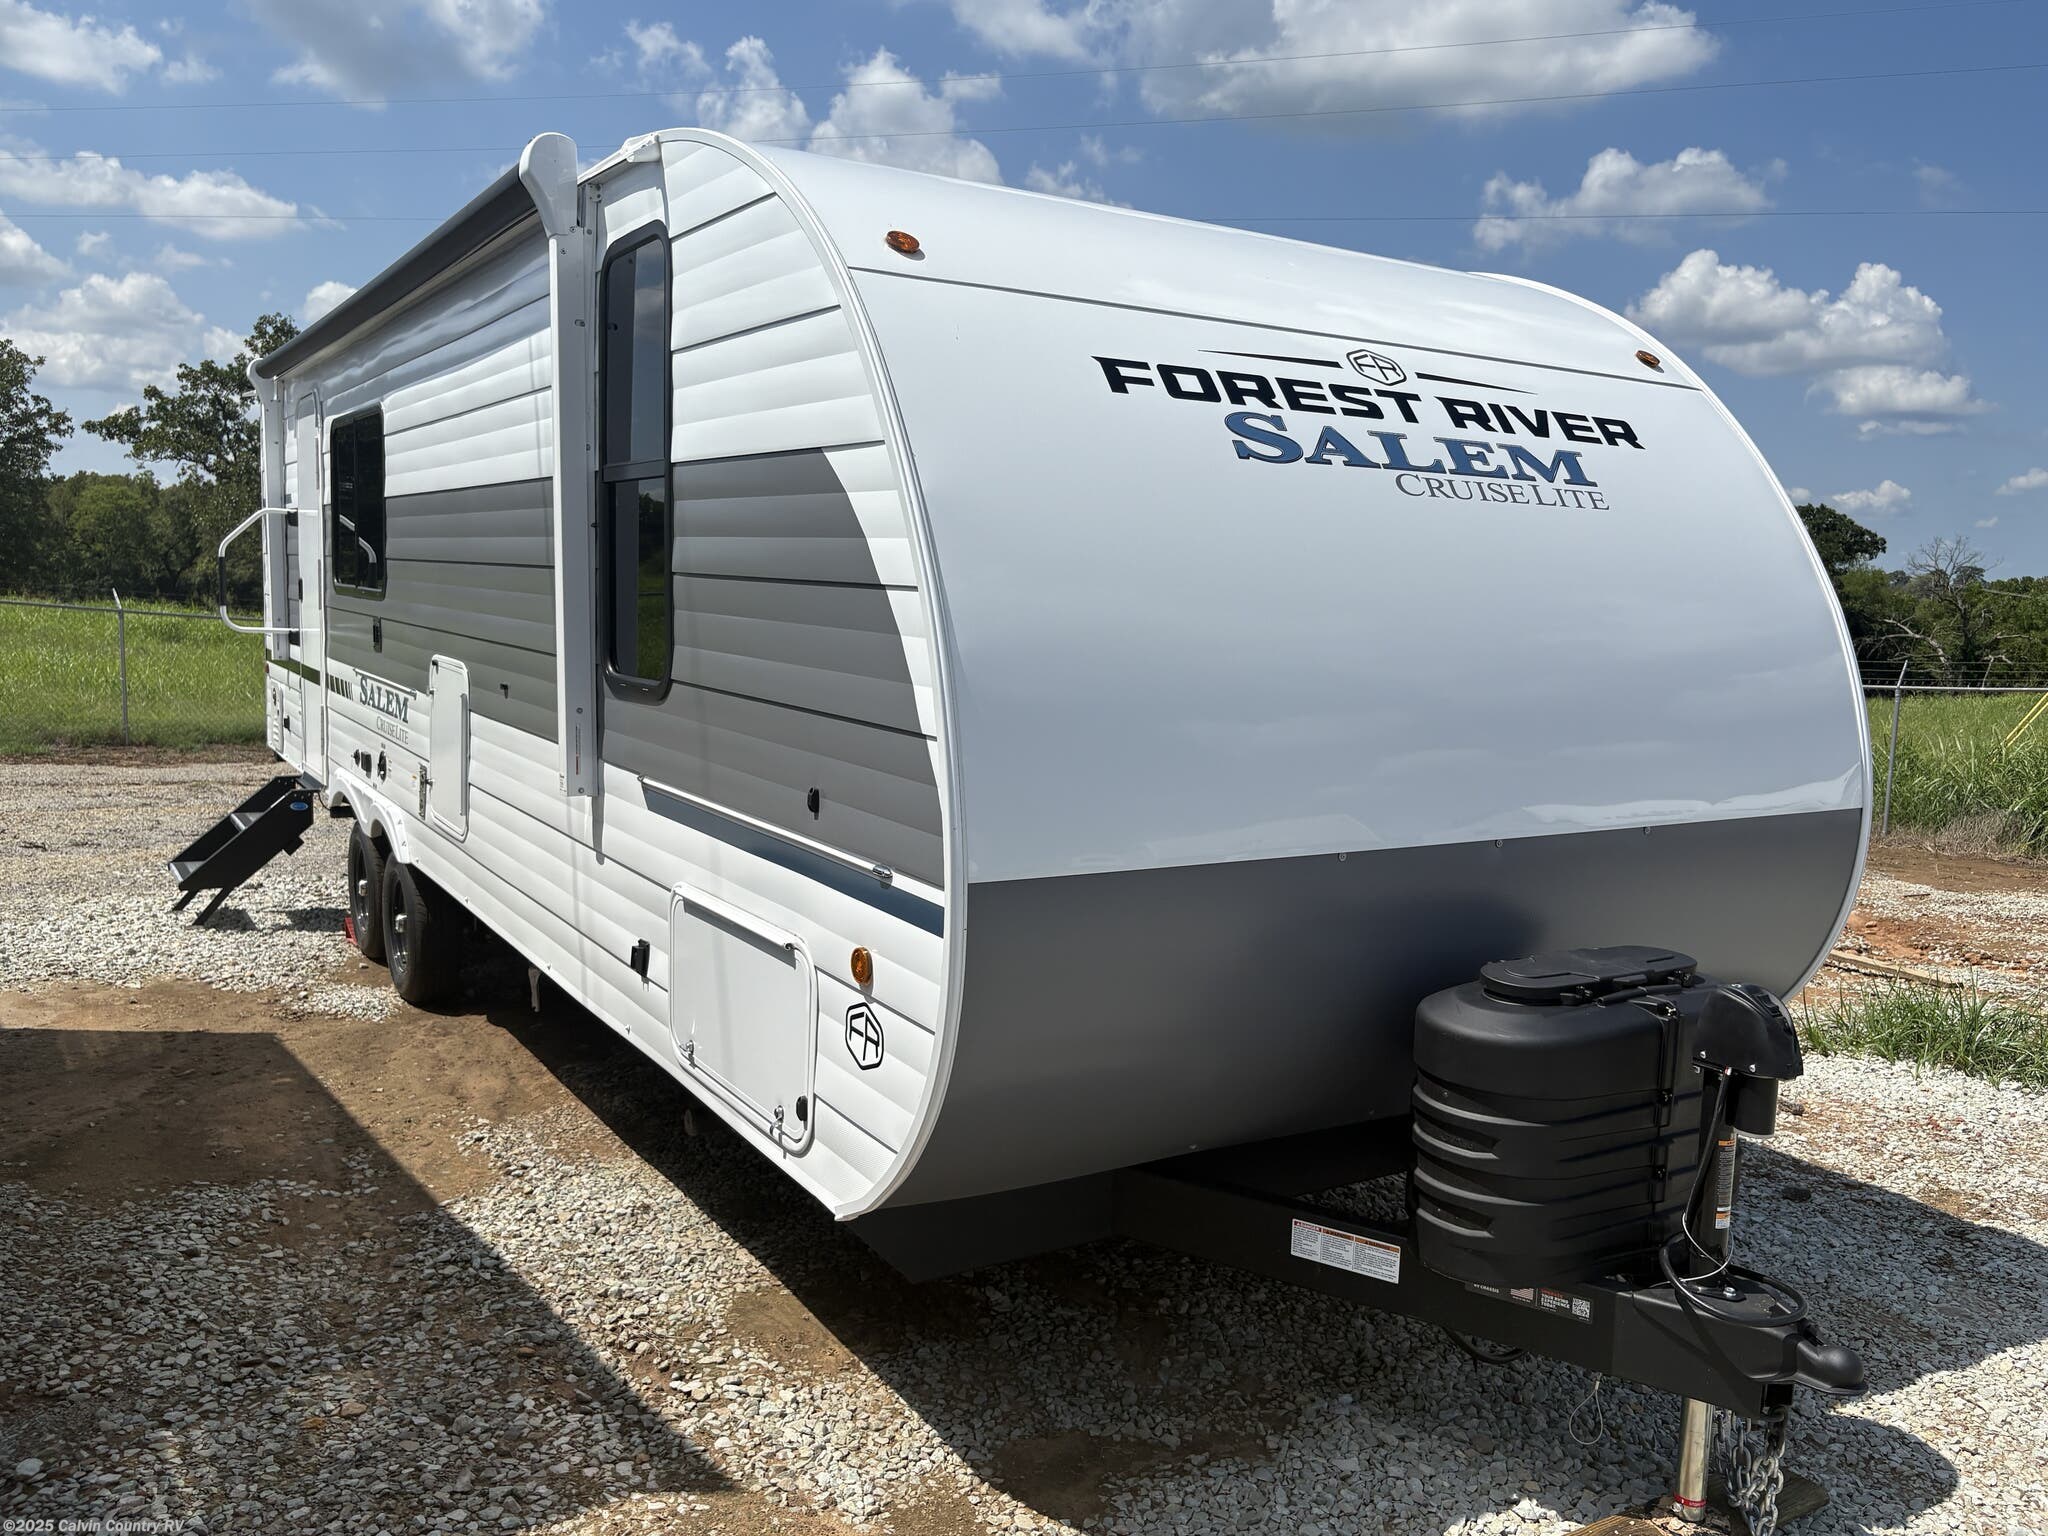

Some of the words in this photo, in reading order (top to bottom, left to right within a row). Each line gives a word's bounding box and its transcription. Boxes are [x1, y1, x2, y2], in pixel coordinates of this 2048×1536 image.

[1091, 355, 1422, 424] FOREST
[1434, 396, 1646, 450] RIVER
[1224, 411, 1599, 488] SALEM
[360, 676, 409, 724] SALEM
